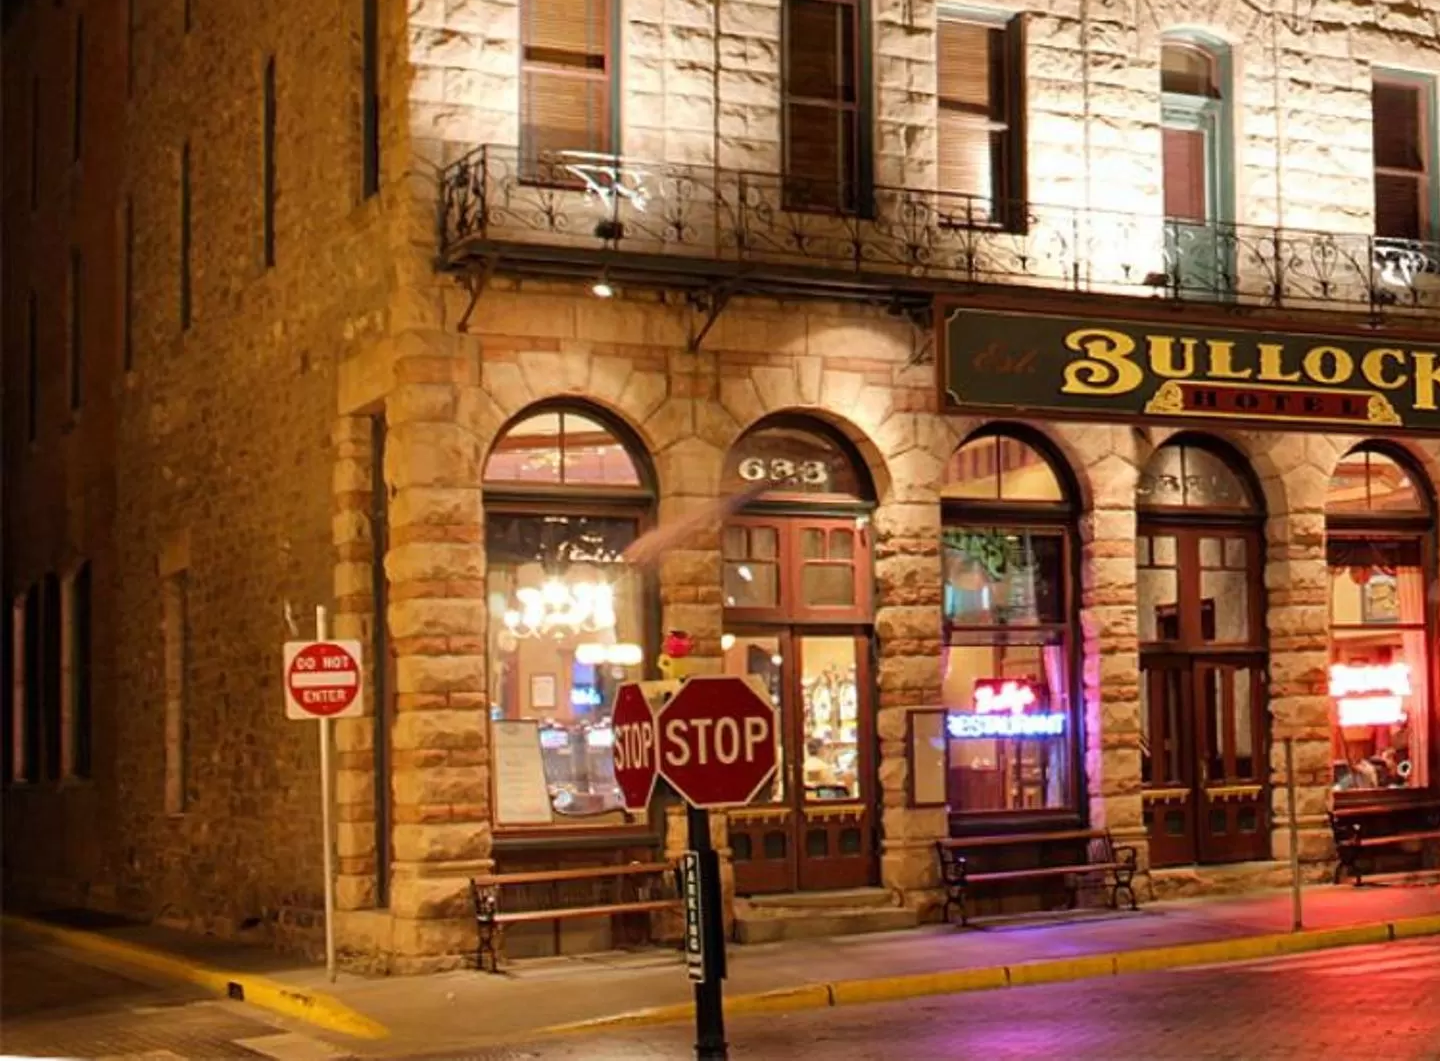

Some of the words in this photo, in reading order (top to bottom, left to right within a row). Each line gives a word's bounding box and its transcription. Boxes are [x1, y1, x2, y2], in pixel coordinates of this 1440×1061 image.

[1191, 387, 1361, 416] HOTEL
[737, 456, 828, 483] 633
[295, 656, 317, 671] DO
[322, 654, 349, 670] NOT
[302, 688, 347, 704] ENTER
[613, 719, 653, 771] STOP
[665, 715, 770, 766] STOP
[686, 855, 700, 952] PARKING
